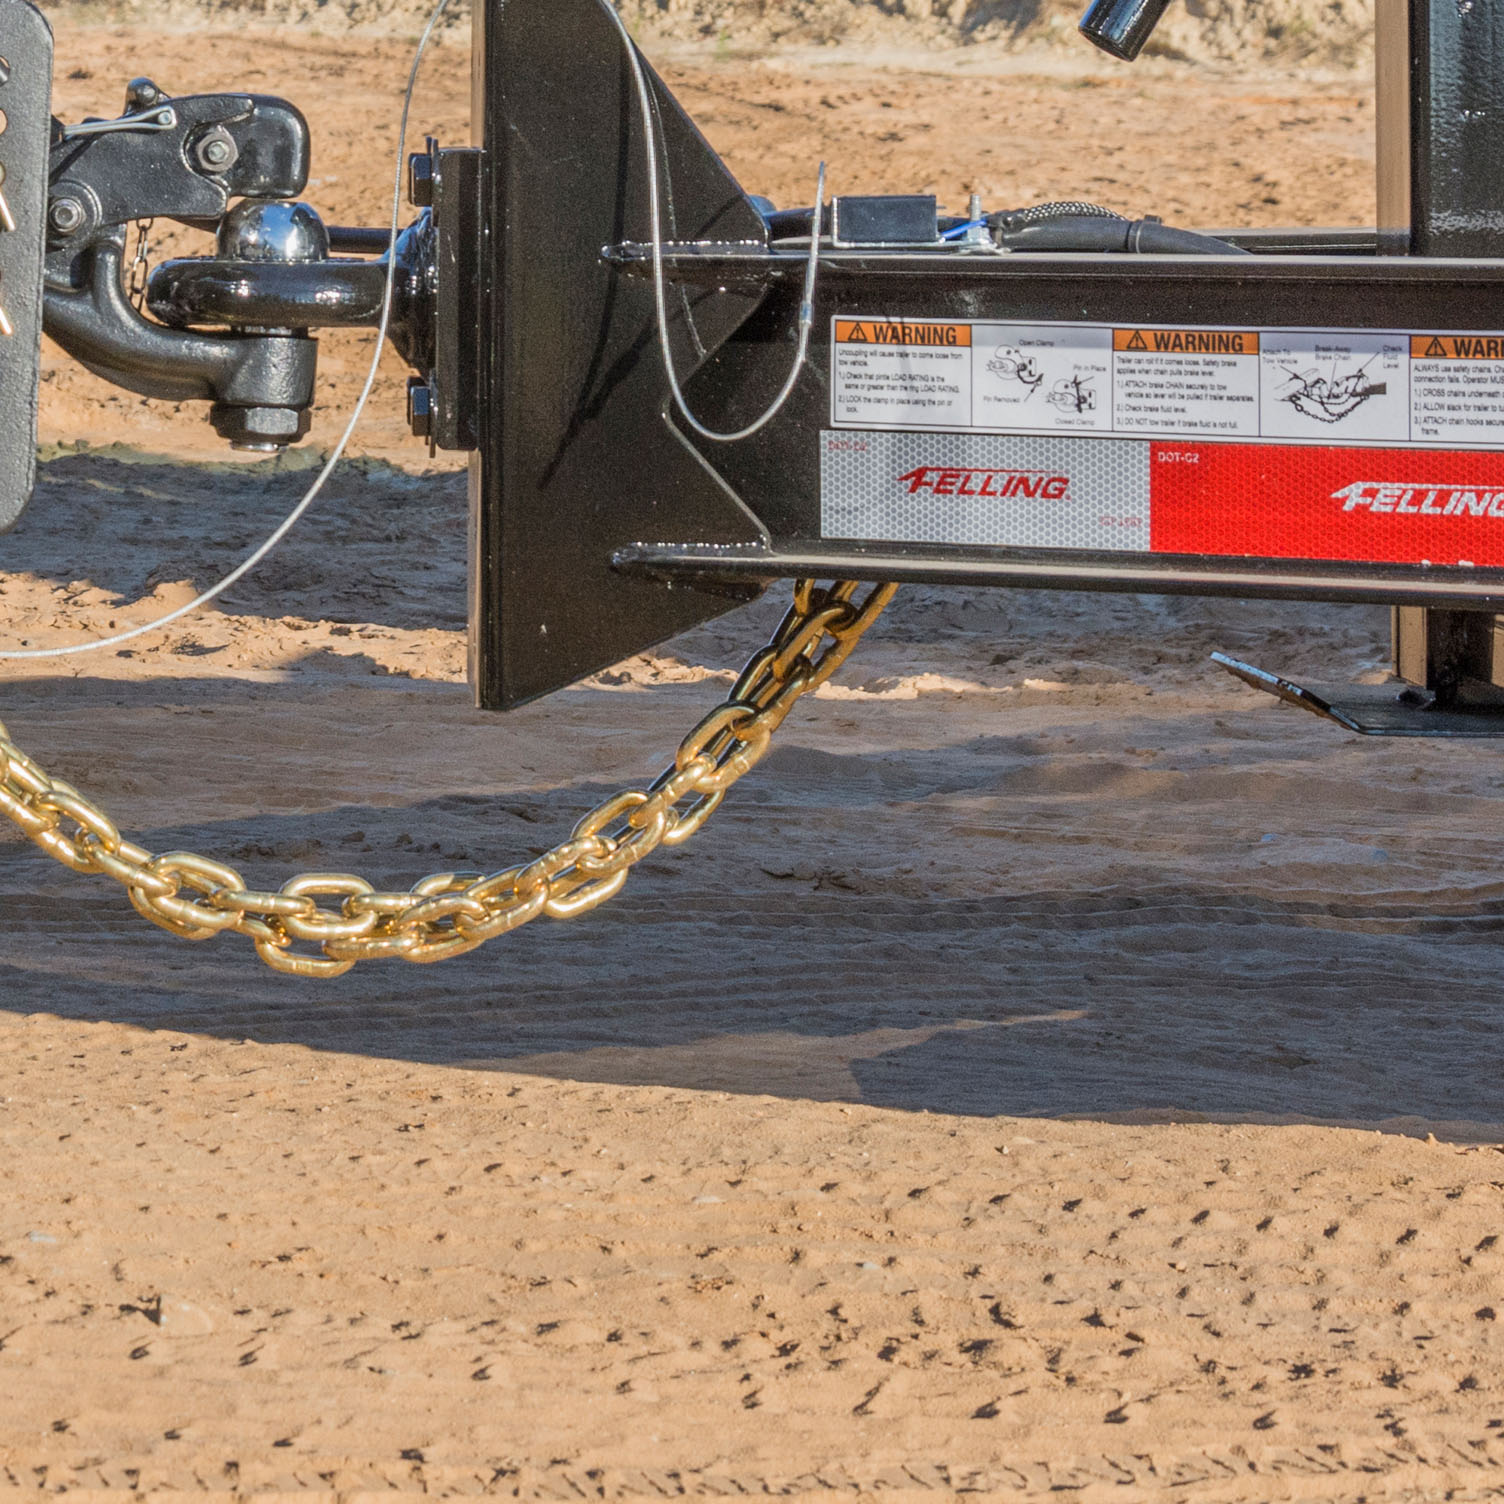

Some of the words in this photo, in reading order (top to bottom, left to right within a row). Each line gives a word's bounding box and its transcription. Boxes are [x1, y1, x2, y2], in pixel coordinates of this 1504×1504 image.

[873, 325, 956, 344] WARNING
[1154, 333, 1243, 352] WARNING
[839, 350, 867, 358] Uncoupling
[1203, 360, 1219, 368] Safety
[1453, 365, 1469, 374] safety
[1186, 383, 1208, 391] securely
[1423, 389, 1445, 397] CROSS
[1125, 404, 1142, 412] Check
[1423, 403, 1445, 411] ALLOW
[1200, 420, 1211, 428] fluid
[1448, 417, 1464, 425] chain
[1466, 417, 1483, 425] hooks
[1158, 451, 1200, 464] DOT-C2
[897, 466, 1070, 500] FELLING
